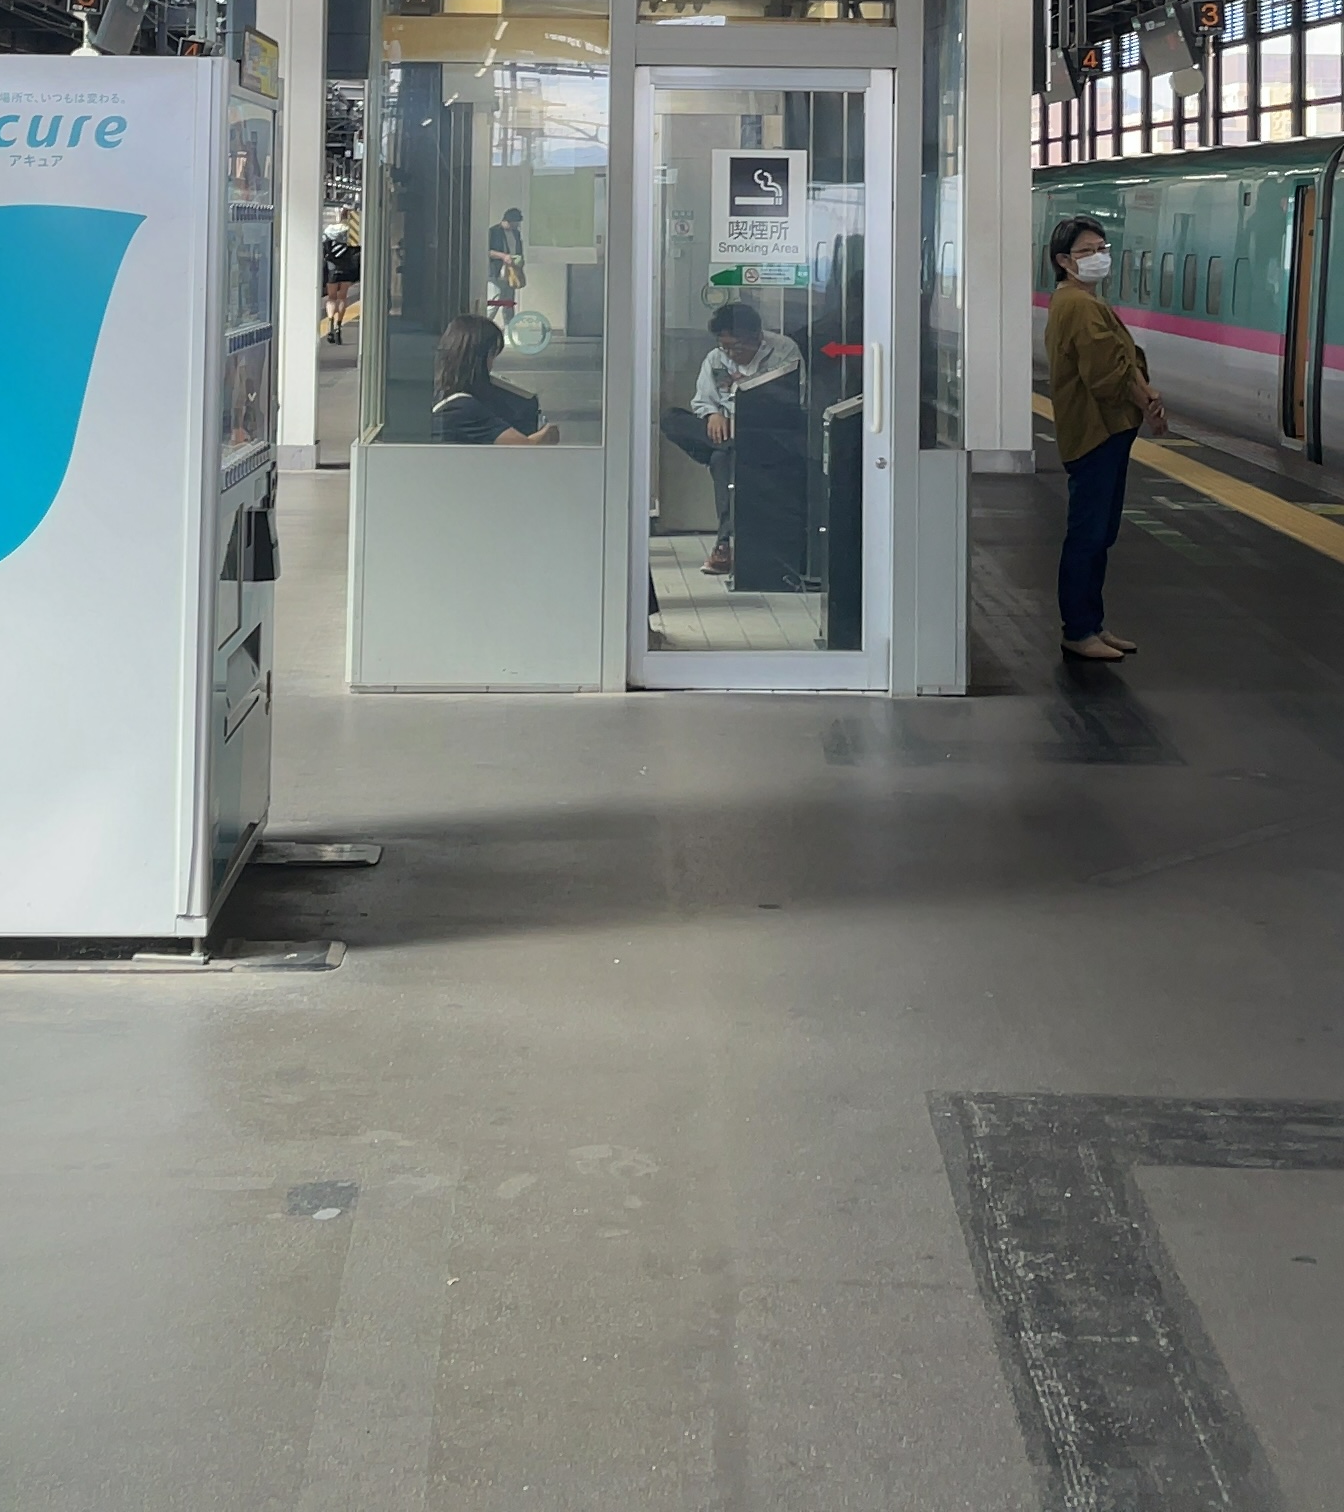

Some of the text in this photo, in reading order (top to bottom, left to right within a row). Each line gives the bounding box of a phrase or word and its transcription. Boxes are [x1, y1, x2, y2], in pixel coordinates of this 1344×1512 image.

[1200, 3, 1219, 26] 3
[1082, 49, 1098, 68] 4
[9, 154, 64, 167] アキュア
[728, 220, 789, 240] 喫煙所
[718, 242, 799, 256] Smoking Area
